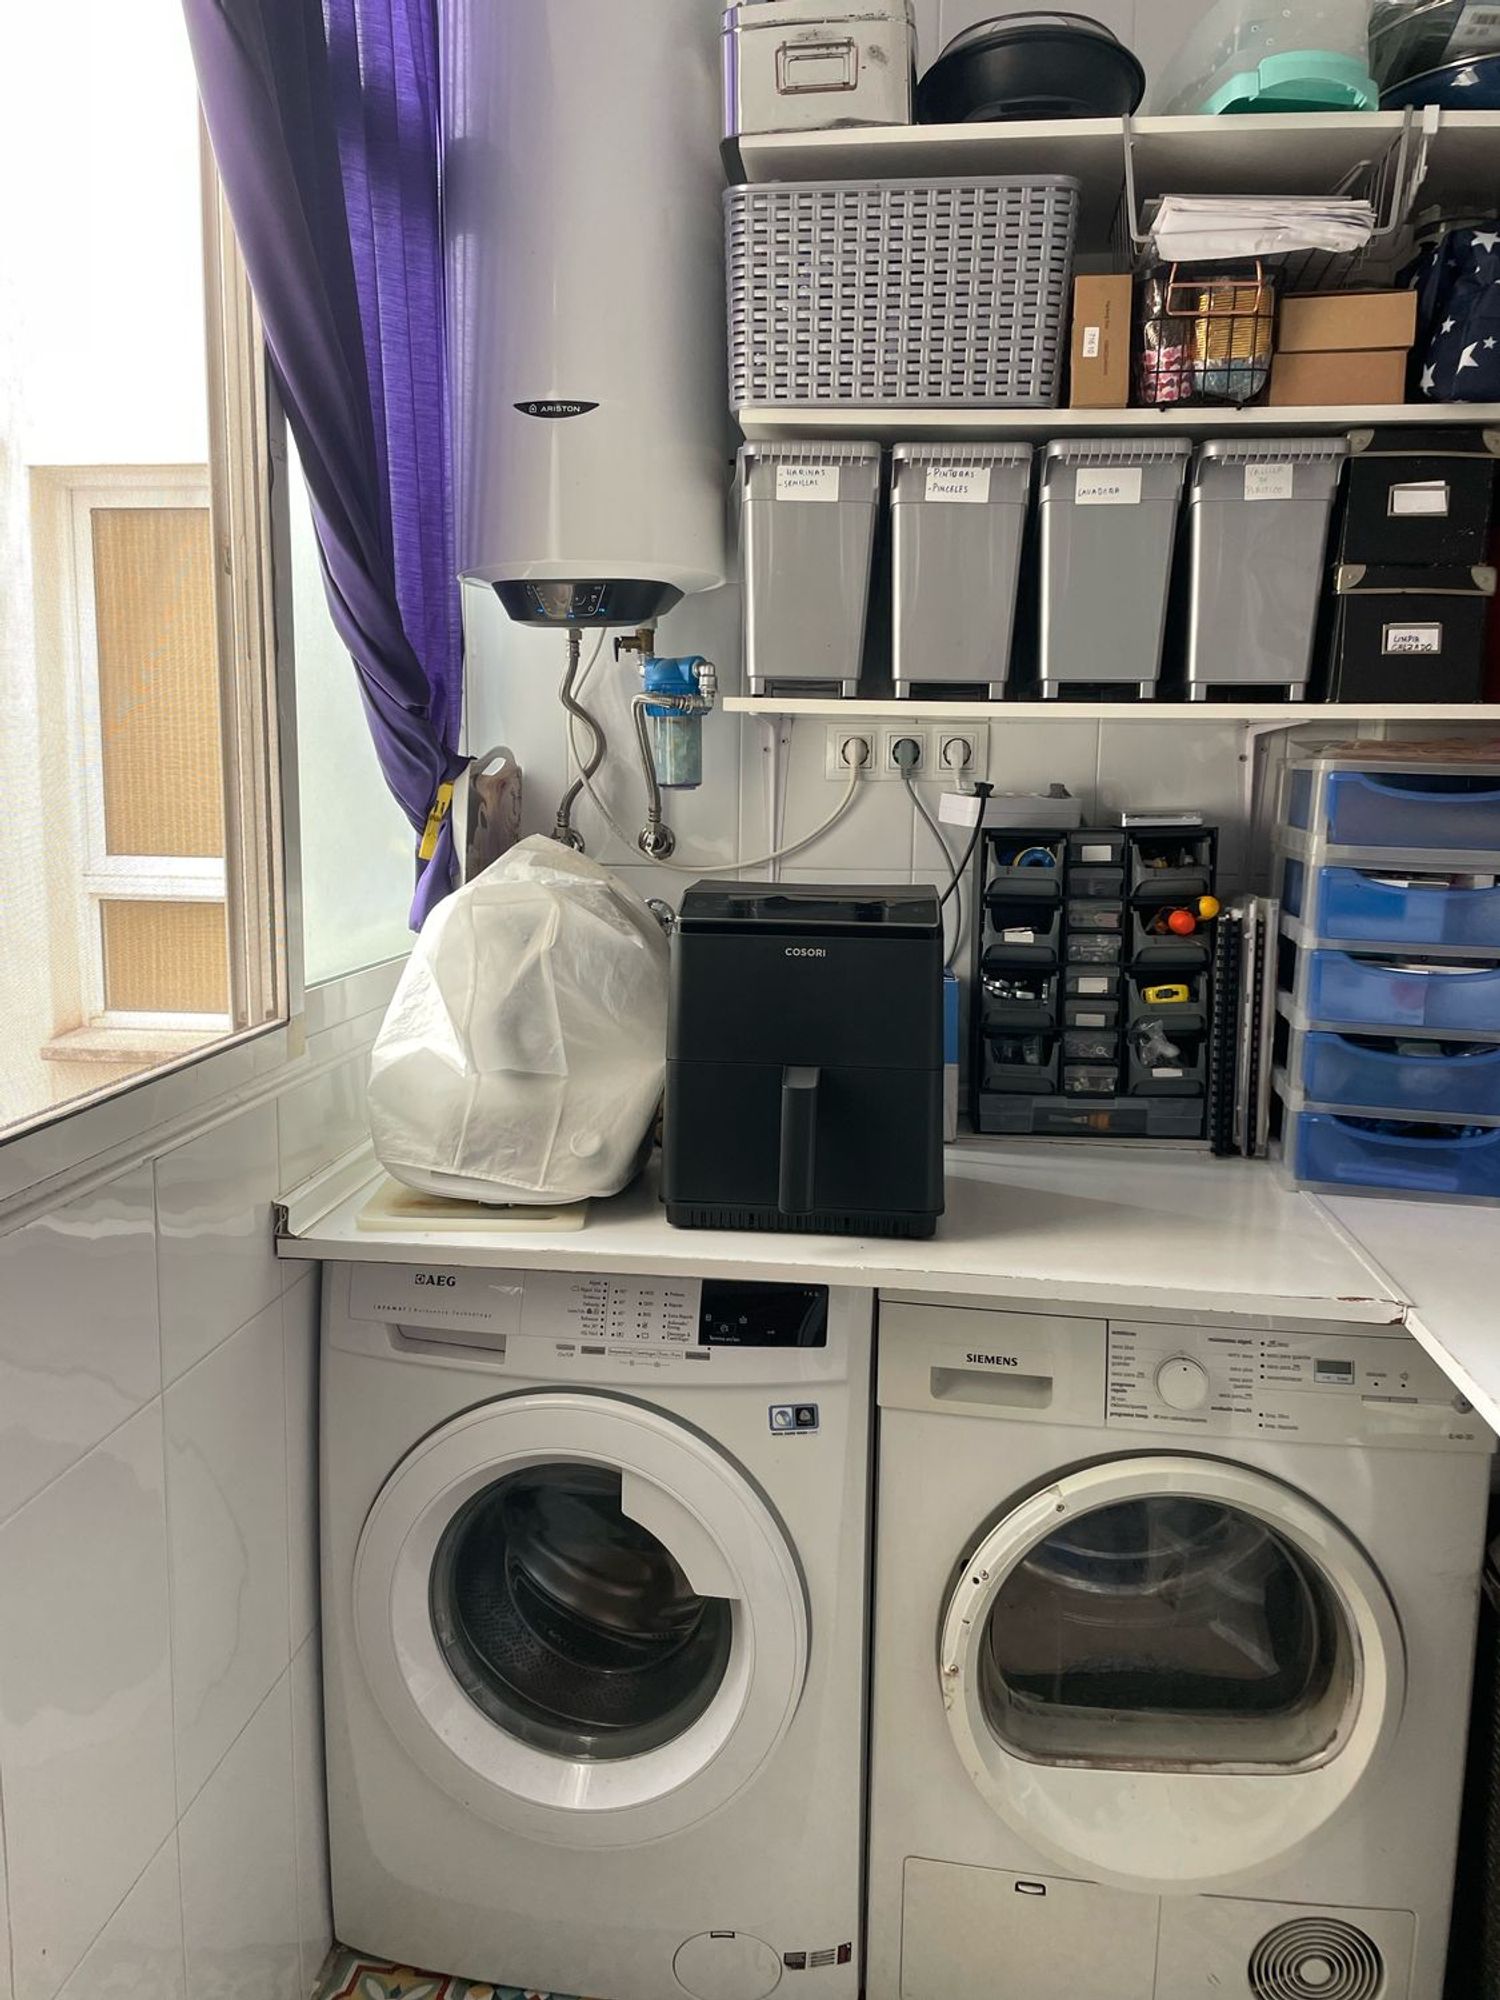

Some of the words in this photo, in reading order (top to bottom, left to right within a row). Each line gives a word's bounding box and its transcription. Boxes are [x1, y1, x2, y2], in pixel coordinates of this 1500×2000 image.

[540, 404, 581, 413] ARISTON
[785, 947, 827, 958] COSORI
[425, 1274, 457, 1287] AEG
[966, 1353, 1019, 1367] SIEMENS
